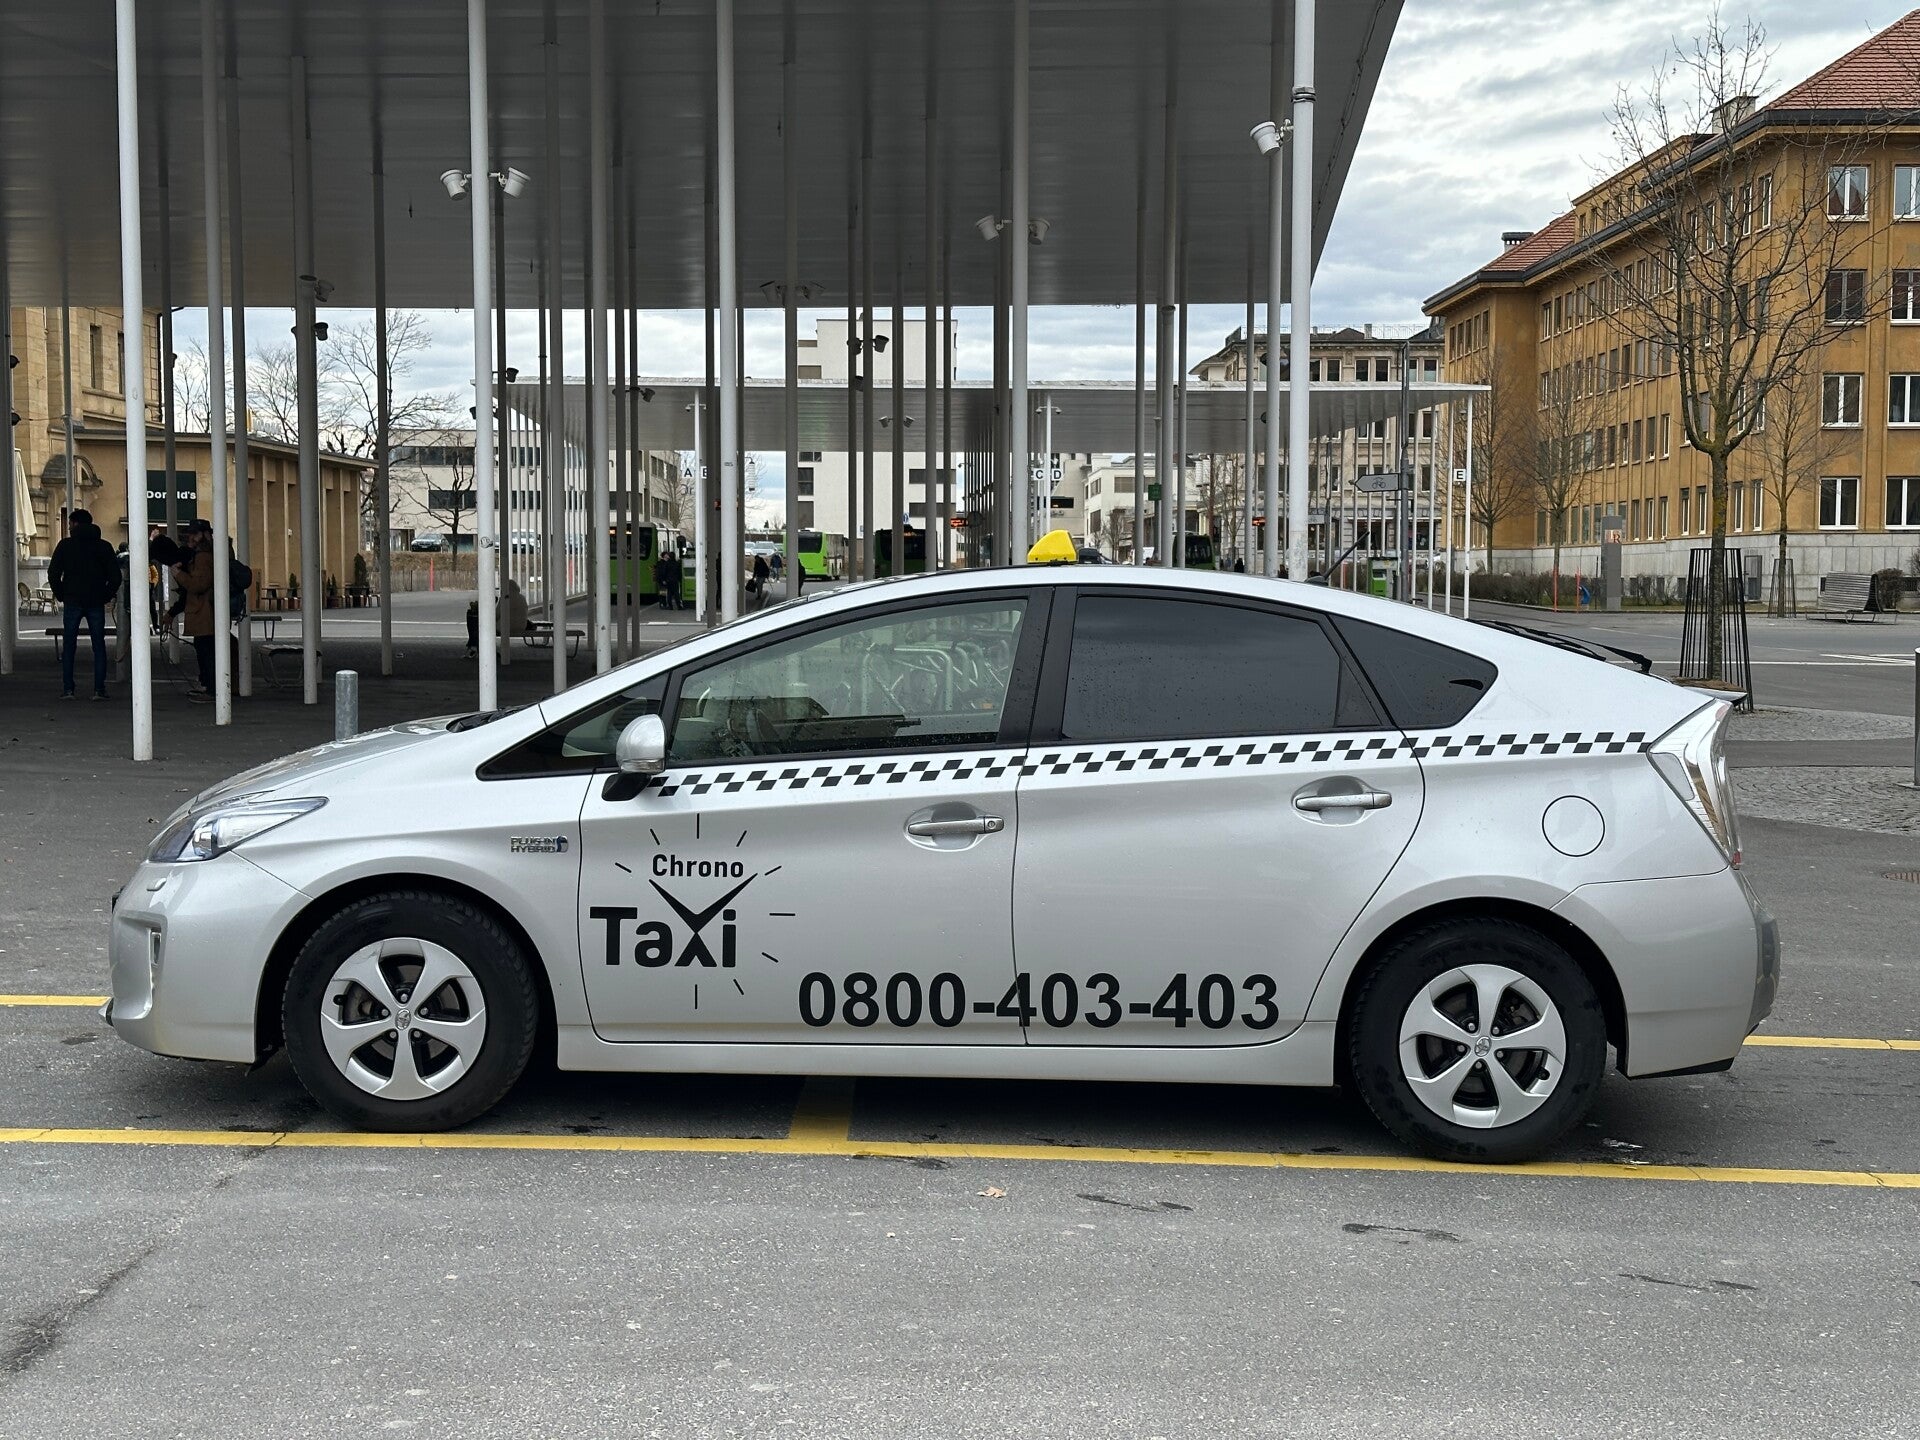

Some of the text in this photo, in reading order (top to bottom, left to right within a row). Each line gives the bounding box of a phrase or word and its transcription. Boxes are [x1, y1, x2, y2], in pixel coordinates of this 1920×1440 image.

[683, 468, 693, 477] A
[1035, 470, 1044, 479] C
[1053, 470, 1062, 480] D
[1456, 470, 1464, 480] E
[510, 845, 557, 853] HYBRID
[652, 854, 744, 877] Chrono
[590, 873, 758, 967] Taxi
[799, 971, 1280, 1030] 0800-403-403
